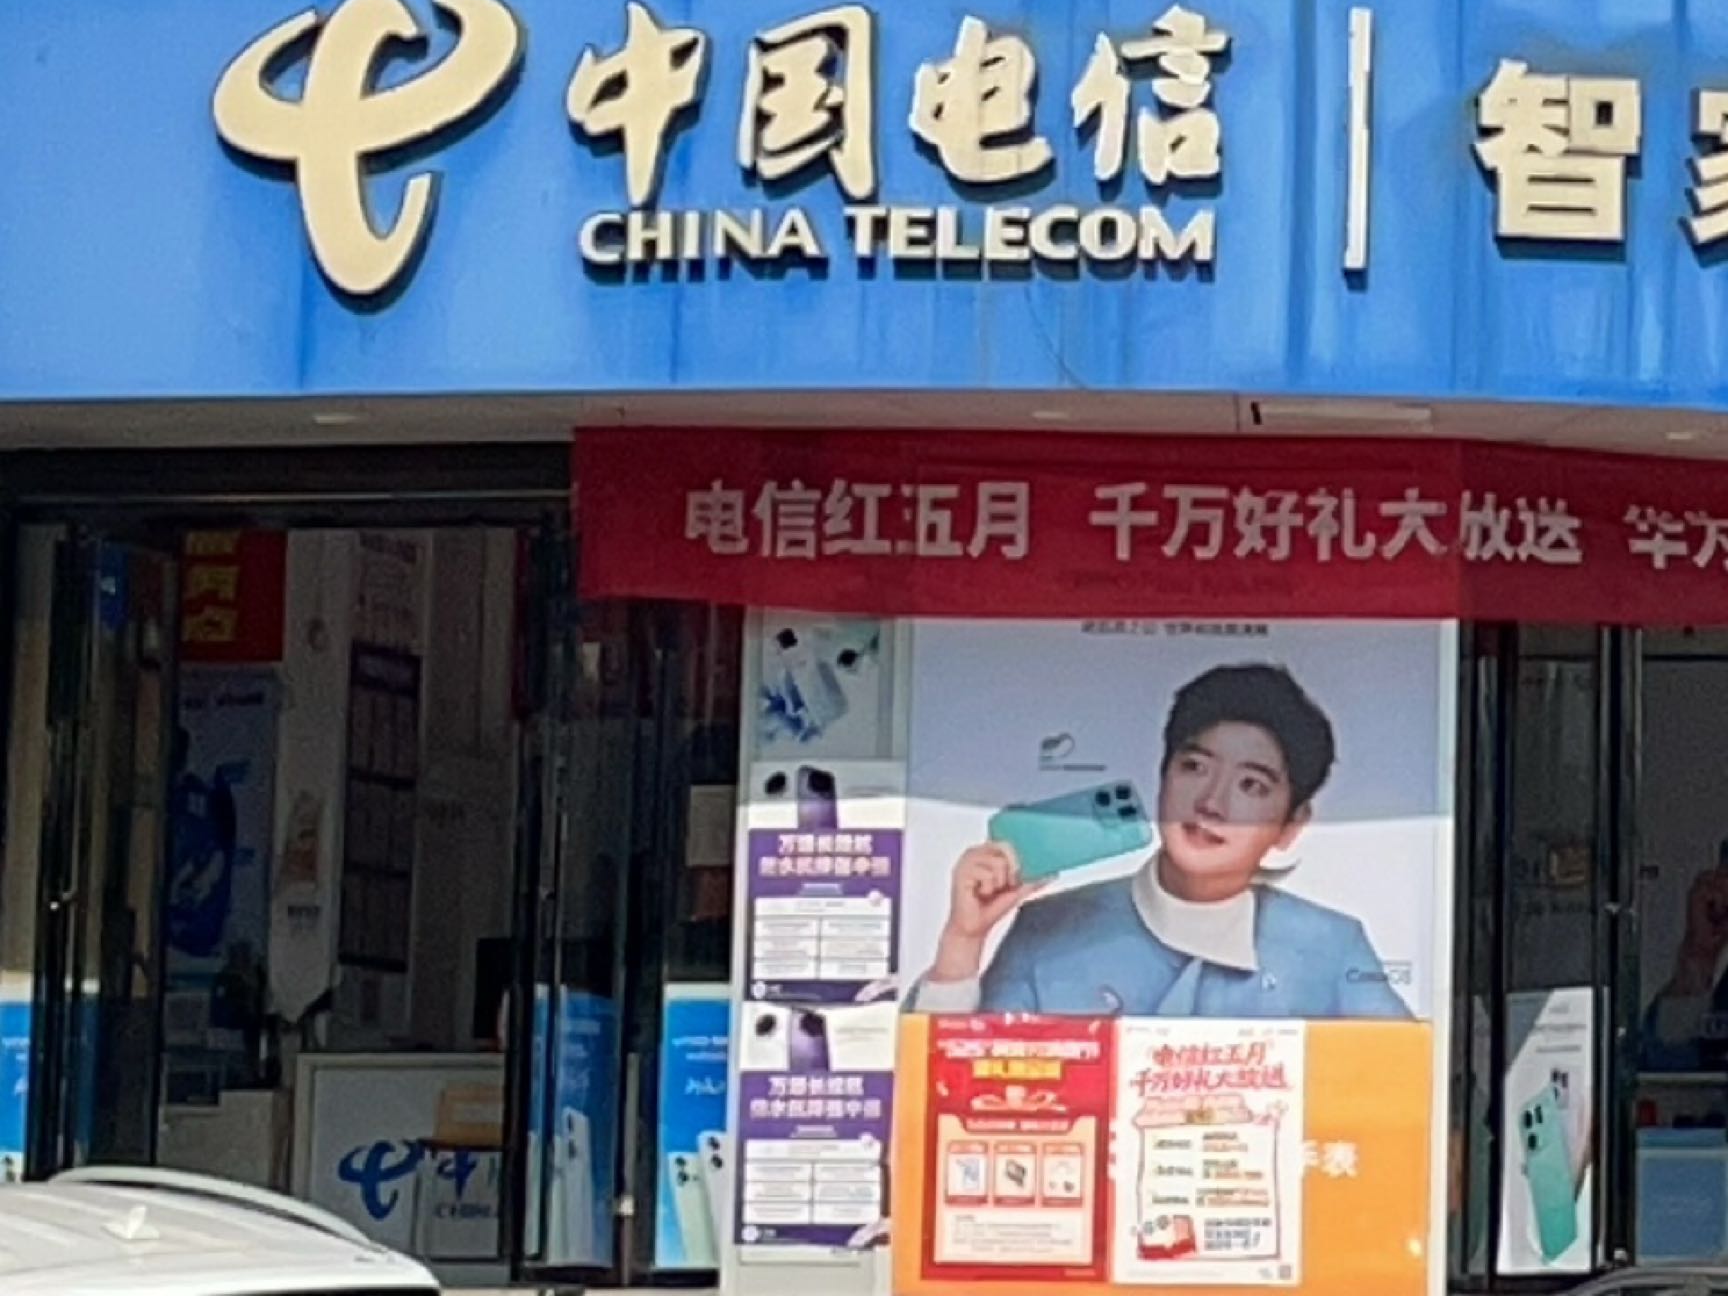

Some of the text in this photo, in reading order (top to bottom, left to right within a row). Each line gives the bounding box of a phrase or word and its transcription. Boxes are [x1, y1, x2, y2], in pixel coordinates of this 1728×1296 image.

[564, 0, 1234, 206] 中国电信
[578, 206, 1216, 266] CHINA TELECOM
[683, 477, 1032, 561] 电信红五月
[1088, 481, 1584, 565] 千万好礼大放送
